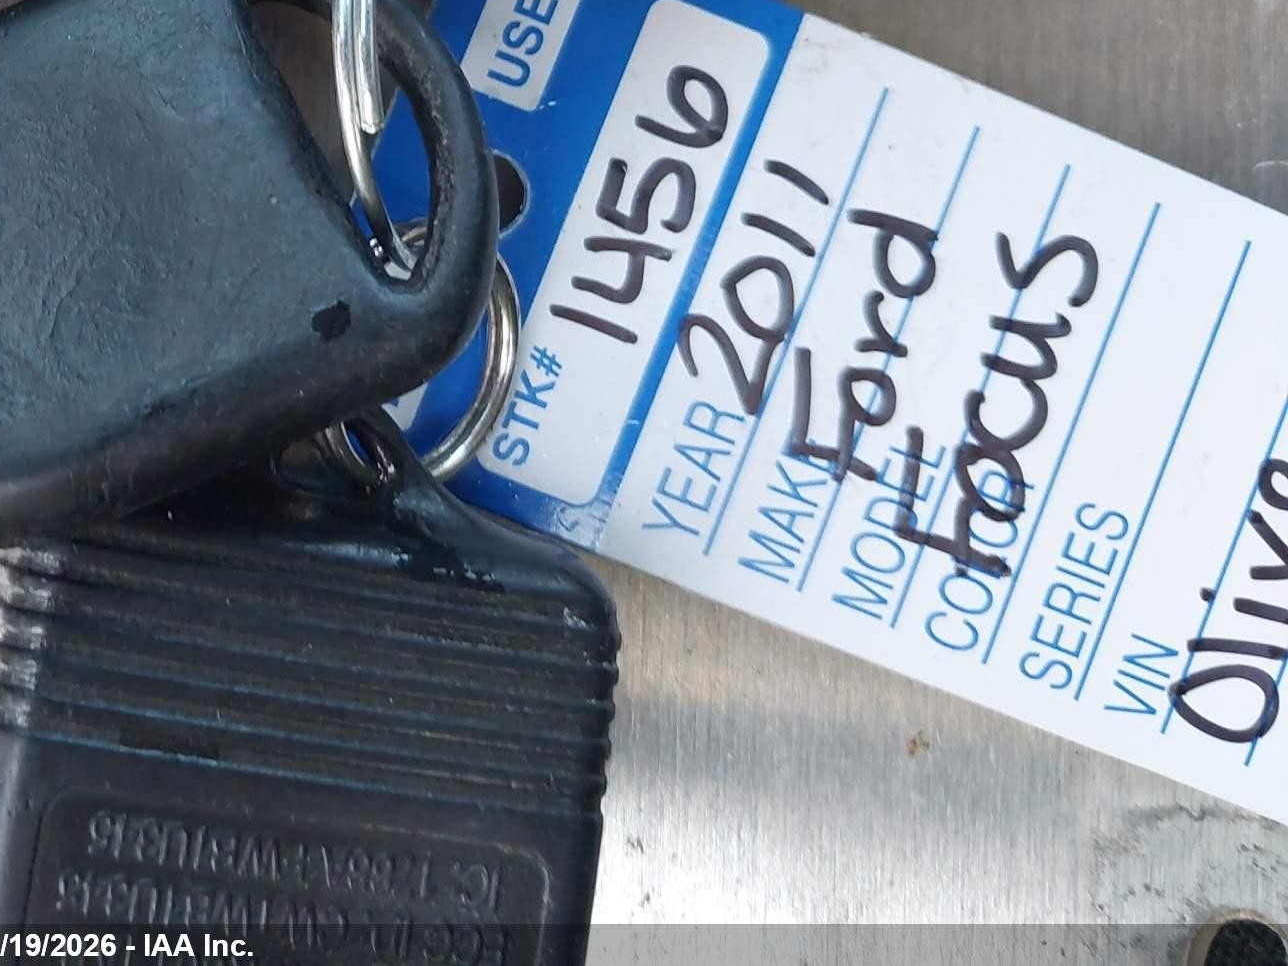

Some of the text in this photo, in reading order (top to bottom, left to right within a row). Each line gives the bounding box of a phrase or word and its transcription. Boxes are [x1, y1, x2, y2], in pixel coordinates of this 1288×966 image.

[549, 64, 729, 345] 1456
[677, 159, 830, 416] 2011
[492, 345, 563, 466] STK#
[786, 207, 939, 482] Ford
[893, 231, 1099, 577] Focus
[642, 399, 745, 537] YEAR
[830, 443, 947, 621] MODEL
[1018, 502, 1130, 690] SERIES
[1103, 632, 1179, 716] VIN
